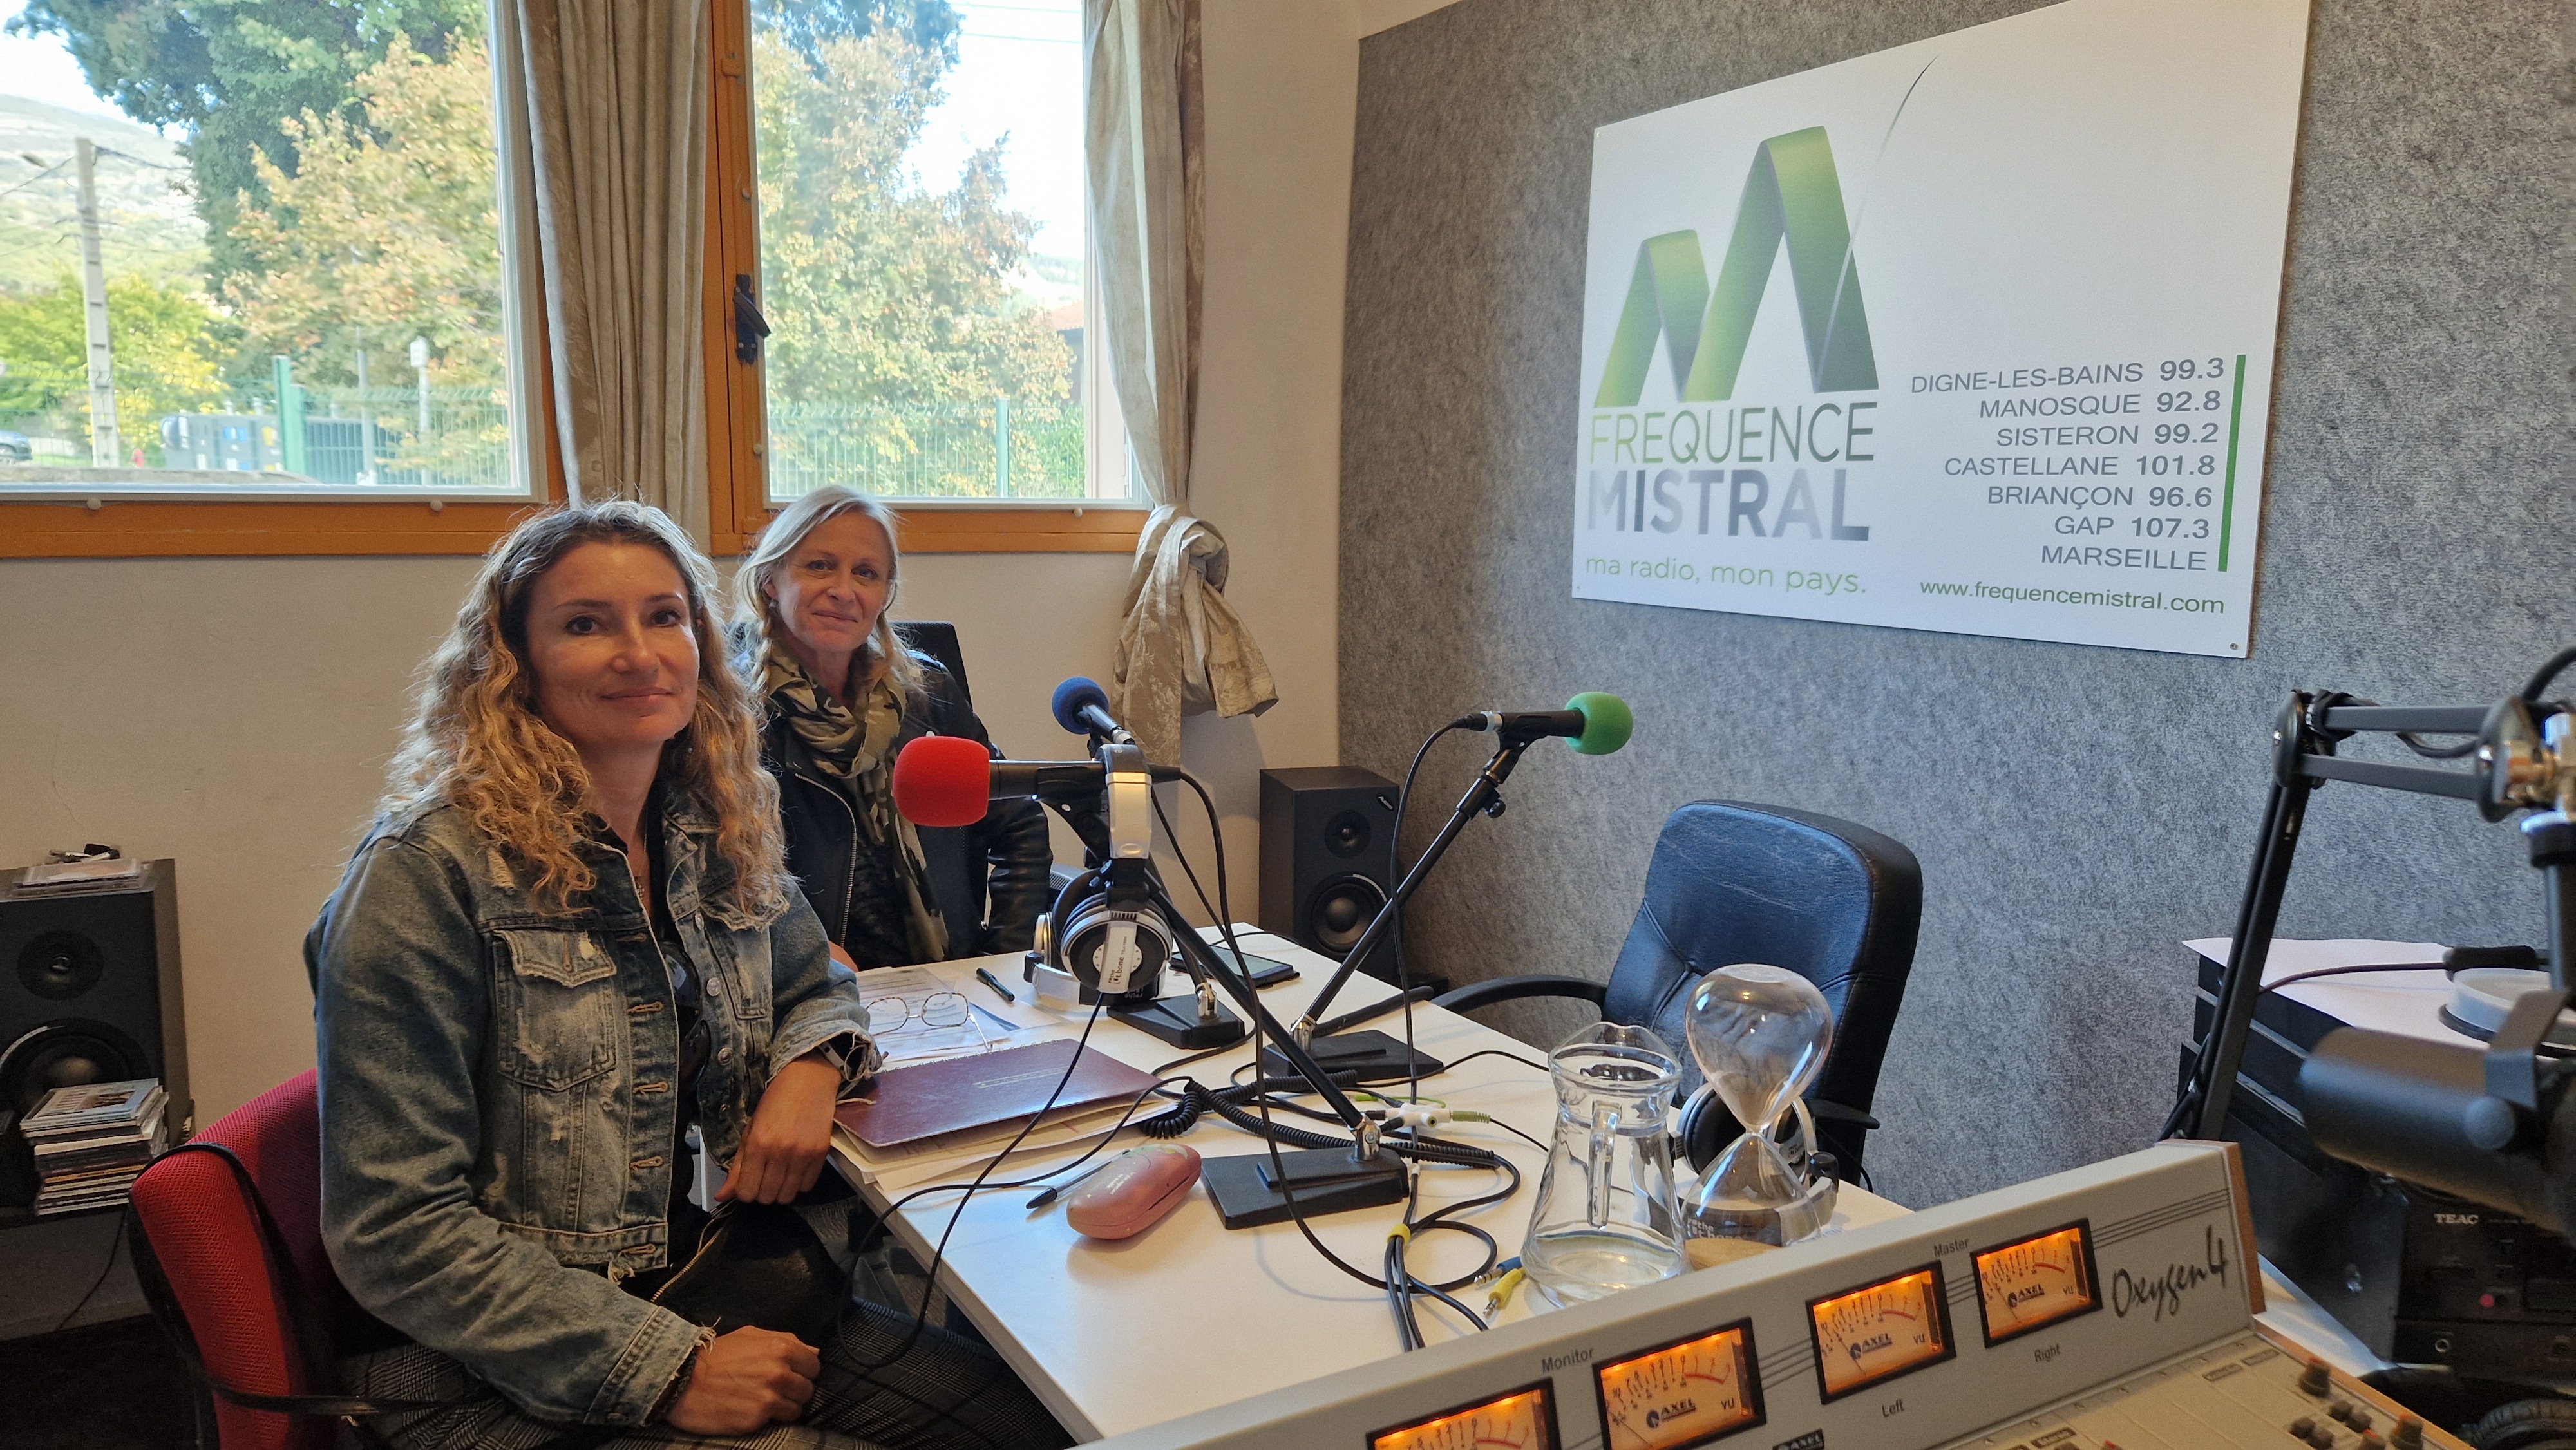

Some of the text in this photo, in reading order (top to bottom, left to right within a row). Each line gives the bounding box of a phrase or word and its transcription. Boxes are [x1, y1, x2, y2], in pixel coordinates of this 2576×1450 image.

[1911, 357, 2225, 394] DIGNE-LES-BAINS 99.3
[1979, 390, 2221, 418] MANOSQUE 92.8
[1589, 401, 1878, 464] FREQUENCE
[1996, 422, 2219, 447] SISTERON 99.2
[1944, 455, 2215, 476] CASTELLANE 101.8
[1586, 468, 1870, 541] MISTRAL
[1987, 486, 2212, 511] BRIANÇON 96.6
[2054, 516, 2210, 540] GAP 107.3
[2041, 546, 2207, 571] MARSEILLE
[1586, 556, 1867, 596] ma radio, mon pays.
[1920, 580, 2225, 614] www.frequencemistral.com
[2434, 1213, 2479, 1225] TEAC
[1933, 1238, 1969, 1257] Master
[2018, 1284, 2044, 1297] AXEL
[1862, 1333, 1891, 1348] AXEL
[1913, 1333, 1925, 1345] VU
[1541, 1348, 1594, 1374] Monitor
[2034, 1344, 2061, 1362] Right
[1660, 1398, 1696, 1416] AXEL
[1721, 1397, 1734, 1410] VU
[1882, 1398, 1905, 1417] Left
